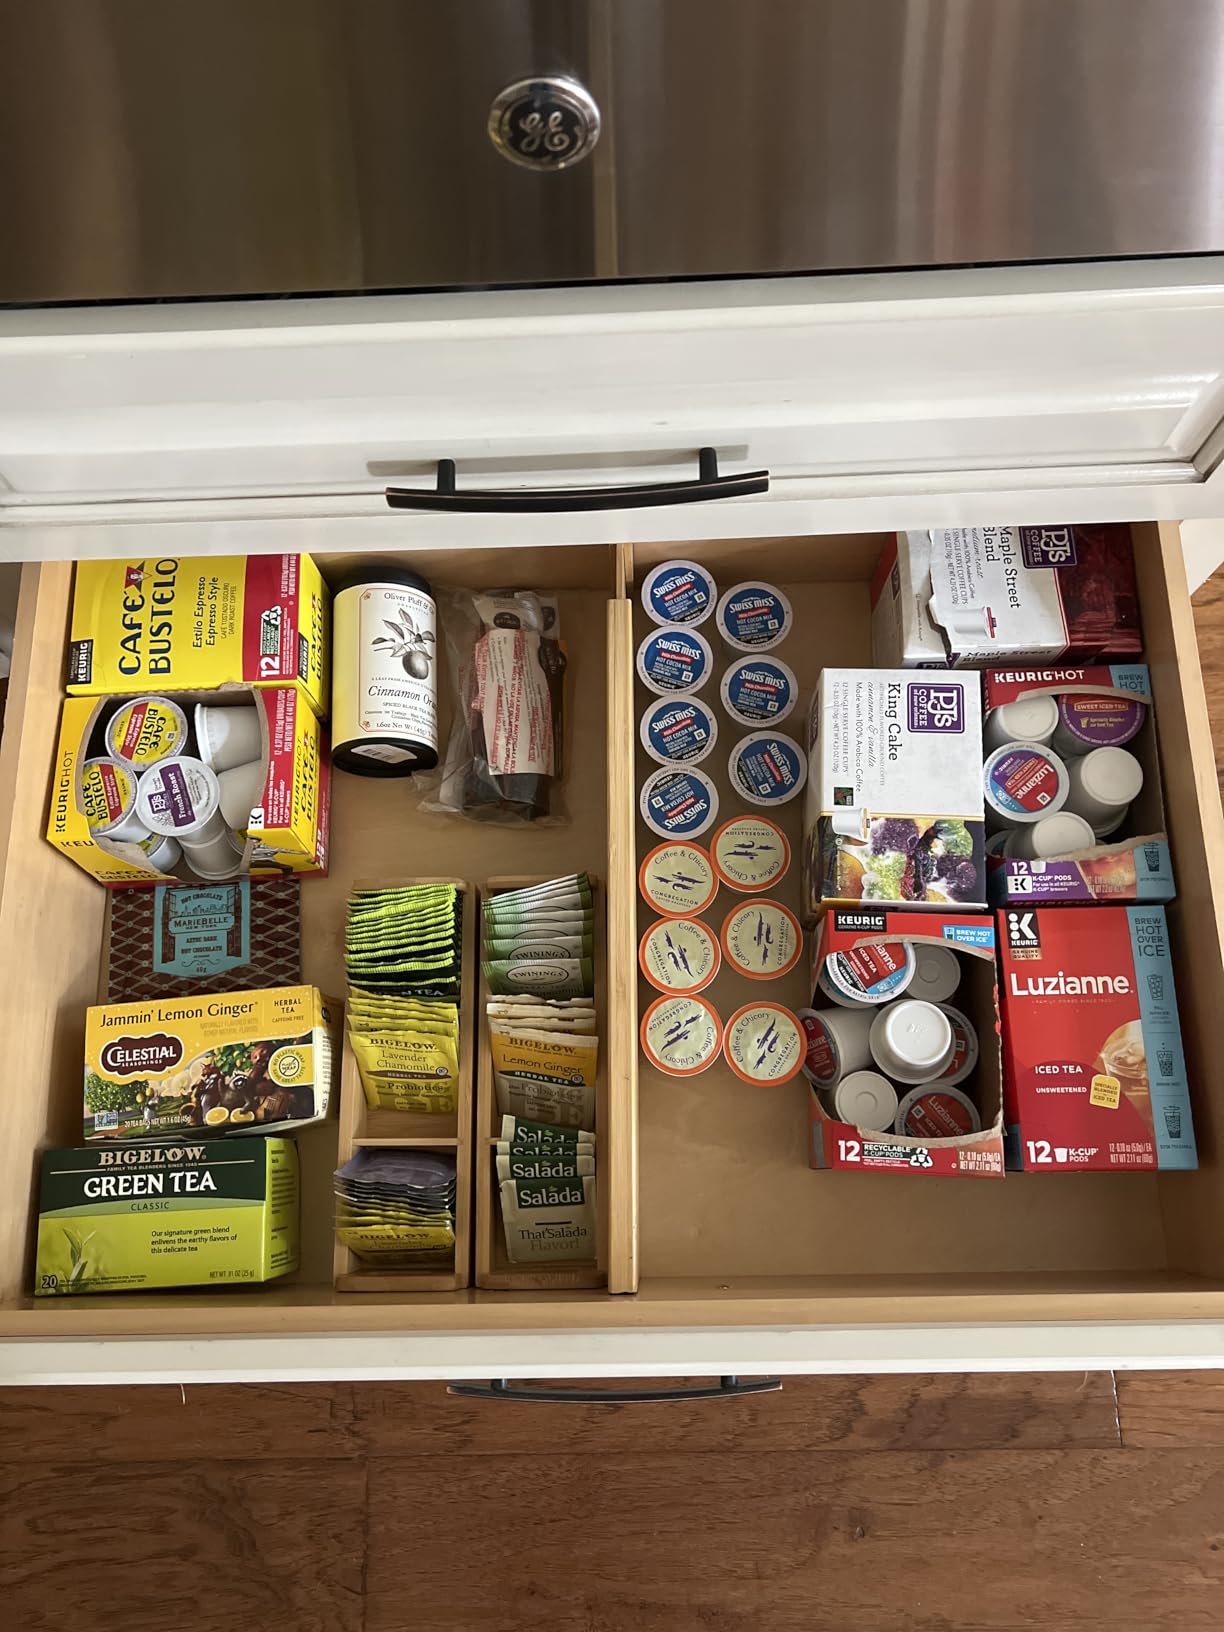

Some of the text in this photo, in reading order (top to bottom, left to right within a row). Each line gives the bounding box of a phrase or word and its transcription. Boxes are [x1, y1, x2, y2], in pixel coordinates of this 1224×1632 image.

[983, 527, 1000, 562] Blend
[1030, 529, 1042, 563] COFFEE
[1000, 526, 1021, 609] Maple Street
[384, 592, 406, 602] Oliver
[653, 580, 676, 598] SWISS
[148, 558, 179, 675] BUSTELO
[193, 576, 207, 648] Estilo Espresso
[206, 577, 221, 646] Espresso Style
[729, 600, 753, 613] SWISS
[118, 591, 145, 675] CAFÉ
[655, 638, 682, 653] SWISS
[78, 642, 89, 682] KEURIG
[260, 656, 280, 677] 12
[739, 669, 765, 683] SWISS
[1119, 681, 1144, 690] HOT
[368, 685, 420, 701] Cinnamon
[867, 682, 875, 723] cinnamon
[918, 689, 928, 727] COFFEE
[135, 707, 159, 756] BUSTELO
[651, 715, 676, 733] SWISS
[885, 683, 903, 761] King Cake
[855, 682, 863, 792] Made with 100% Arabica Coffee
[868, 736, 876, 768] vanilla
[1015, 764, 1055, 799] Luzianne
[89, 771, 108, 820] BUSTELO
[168, 772, 187, 818] French Roast
[654, 850, 678, 865] Coffee
[687, 852, 709, 878] Chicory
[724, 860, 748, 881] Chicory
[758, 860, 780, 879] Coffee
[1012, 862, 1028, 875] 12
[650, 889, 699, 906] CONGREGATION
[174, 916, 229, 928] MARIEBELLE
[733, 910, 756, 934] Chicory
[838, 915, 884, 925] KEURIG
[1134, 917, 1161, 925] BREW
[778, 916, 786, 965] CONGREGATION
[1135, 926, 1162, 935] HOT
[1137, 936, 1163, 944] OVER
[515, 950, 566, 960] TWININGS
[678, 922, 711, 976] Coffee & Chicory
[732, 944, 750, 966] Coffee
[1138, 946, 1165, 957] ICE
[650, 937, 673, 985] CONGREGATION
[859, 947, 877, 974] ICED TEA
[511, 970, 564, 978] TWININGS
[1010, 971, 1129, 996] Luzianne
[274, 998, 302, 1007] HERBAL
[281, 1006, 295, 1014] TEA
[100, 1002, 254, 1028] Jammin' Lemon Ginger
[648, 1001, 692, 1031] CONGREGATION
[370, 1038, 437, 1050] BIGELOW
[509, 1037, 577, 1055] BIGELOW
[665, 1026, 714, 1066] Coffee & Chicory
[733, 1012, 770, 1063] Coffee & Chicory
[106, 1044, 177, 1068] CELESTIAL
[121, 1059, 163, 1068] SEASONINGS
[382, 1050, 427, 1063] Lavender
[768, 1032, 798, 1077] CONGREGATION
[376, 1059, 435, 1072] Chamomile
[503, 1054, 583, 1076] Lemon Ginger
[1034, 1065, 1083, 1074] ICED TEA
[387, 1082, 443, 1092] Probiotics
[515, 1071, 569, 1085] HERBAL TEA
[928, 1095, 964, 1136] Luzianne
[98, 1146, 205, 1166] BIGELOW
[838, 1140, 860, 1162] 12
[863, 1144, 911, 1153] RECYCLABLE
[1026, 1140, 1053, 1163] 12
[512, 1162, 575, 1178] Salada
[83, 1170, 217, 1198] GREEN TEA
[130, 1202, 170, 1211] CLASSIC
[519, 1187, 582, 1206] Salada
[163, 1228, 193, 1238] signature
[193, 1228, 211, 1237] green
[212, 1226, 230, 1234] blend
[188, 1236, 208, 1245] earthy
[209, 1235, 229, 1243] flavors
[230, 1234, 237, 1242] of
[163, 1245, 187, 1253] delicate
[42, 1275, 57, 1288] 20
